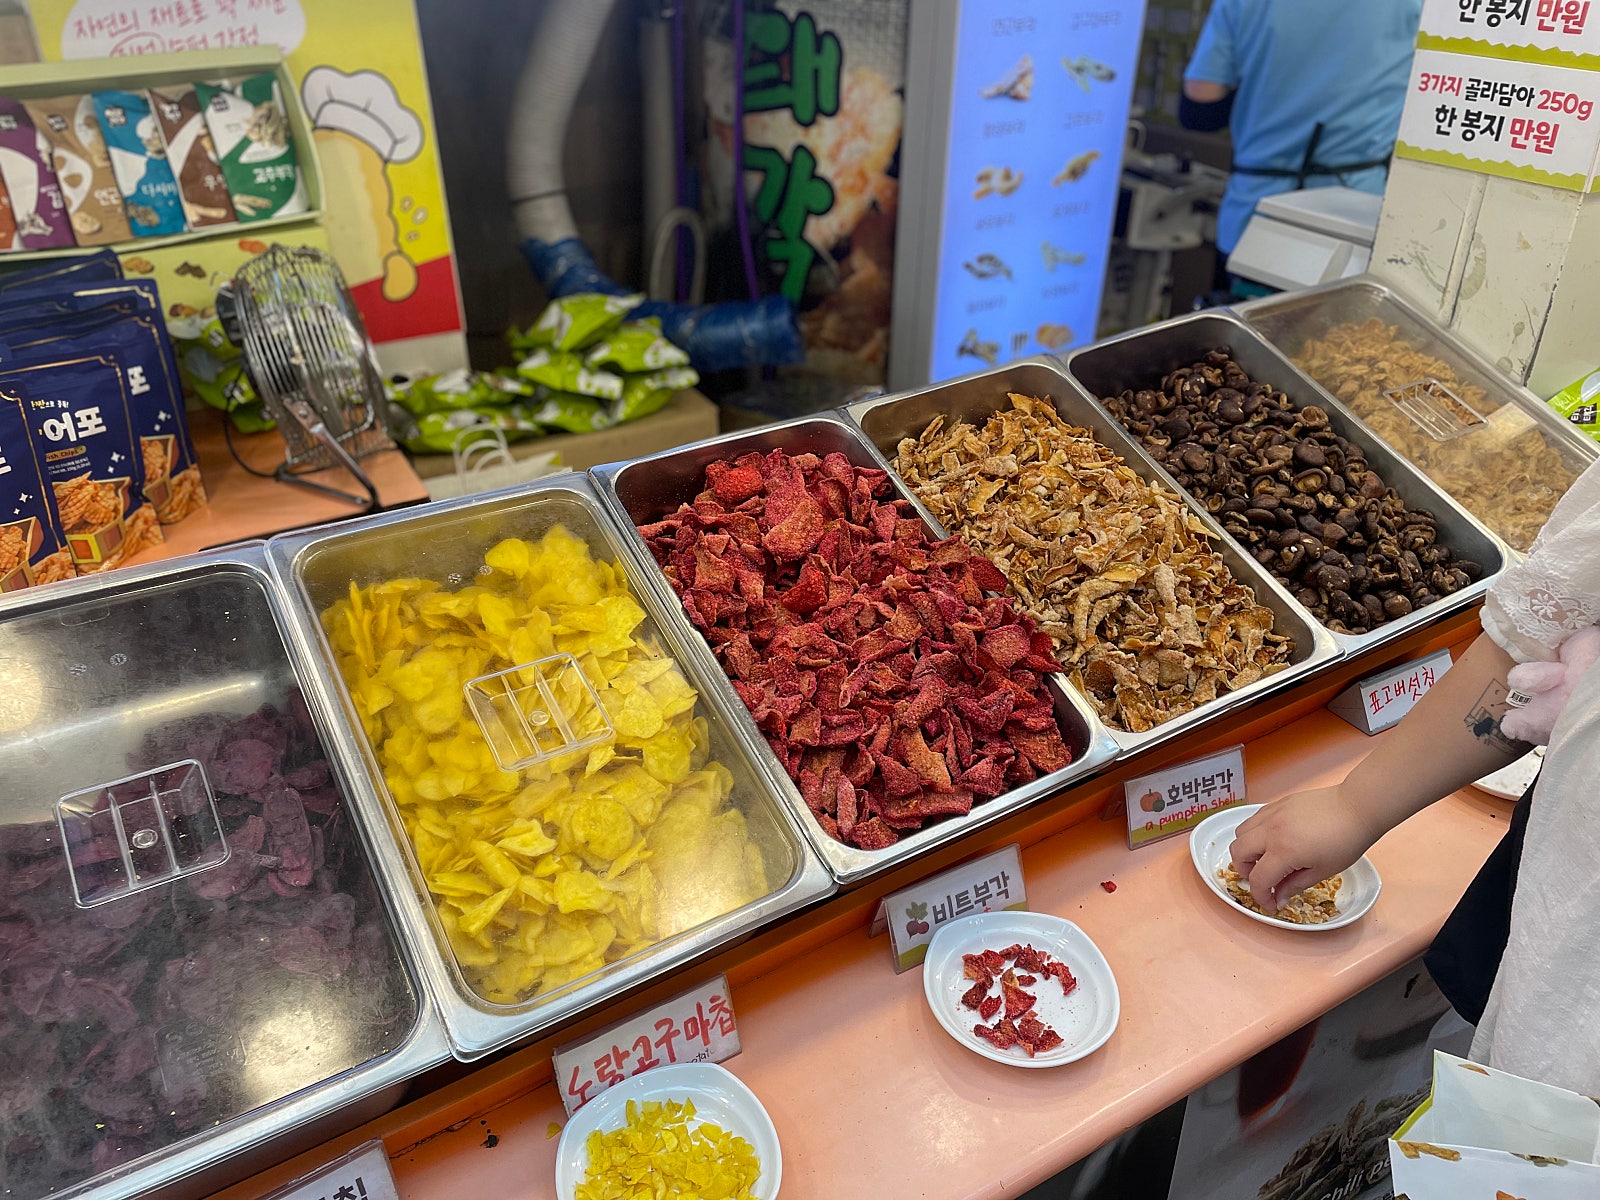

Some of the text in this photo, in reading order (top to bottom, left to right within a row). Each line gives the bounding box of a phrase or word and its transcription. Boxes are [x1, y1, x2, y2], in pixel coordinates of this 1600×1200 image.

[1485, 0, 1532, 28] 봉지
[1536, 0, 1591, 35] 만원
[1418, 72, 1594, 121] 3가지 골라담아 250g
[1434, 104, 1560, 155] 한 봉지 만원
[42, 406, 107, 443] 어포
[1166, 768, 1235, 807] 호박부각
[1159, 801, 1208, 831] pumpkin
[1210, 791, 1237, 810] Shell
[931, 870, 1011, 925] 비트부각
